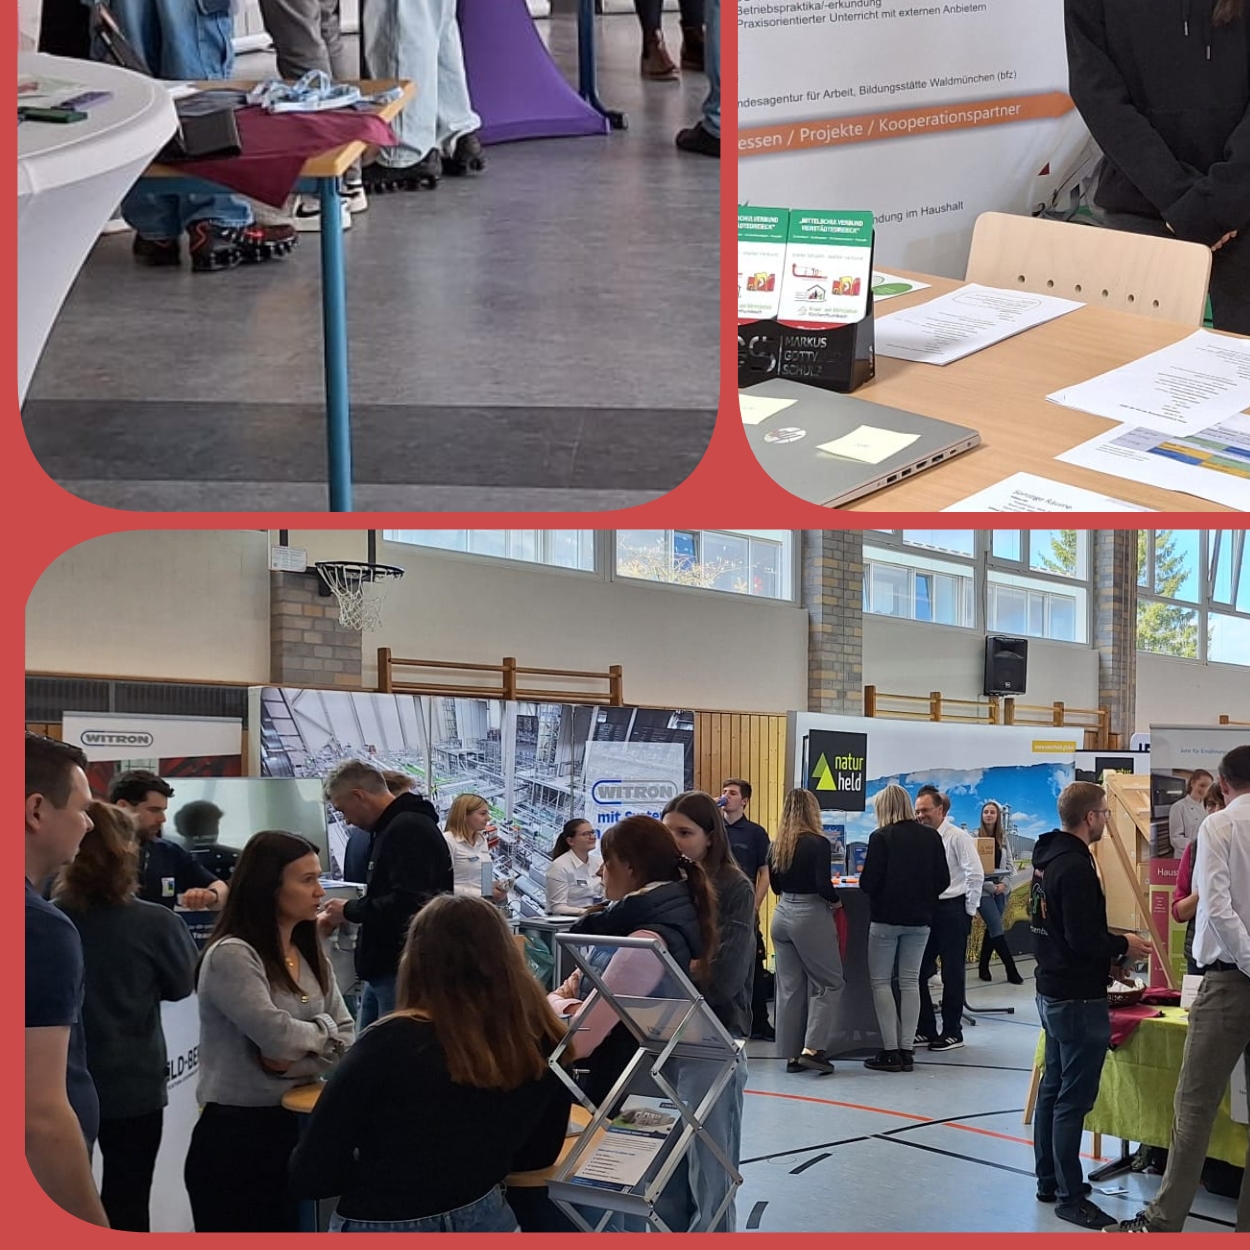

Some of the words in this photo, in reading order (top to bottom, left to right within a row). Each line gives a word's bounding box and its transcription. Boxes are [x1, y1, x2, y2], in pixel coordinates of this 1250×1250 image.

[738, 14, 826, 29] Praxisorientierter
[830, 10, 880, 22] Unterricht
[882, 9, 896, 19] mit
[898, 6, 941, 18] externen
[943, 2, 986, 14] Anbietern
[806, 90, 820, 101] für
[823, 87, 856, 100] Arbeit,
[859, 79, 927, 96] Bildungsstätte
[930, 72, 996, 87] Waldmünchen
[998, 70, 1017, 82] (bfz)
[787, 129, 794, 143] /
[800, 122, 864, 143] Projekte
[868, 120, 875, 136] /
[878, 102, 1021, 132] Kooperationspartner
[906, 208, 918, 219] im
[920, 201, 964, 216] Haushalt
[784, 336, 827, 348] MARKUS
[84, 733, 150, 745] WITRON
[834, 753, 864, 772] natur
[837, 772, 862, 792] held
[598, 786, 673, 799] WITRON
[598, 810, 621, 824] mit
